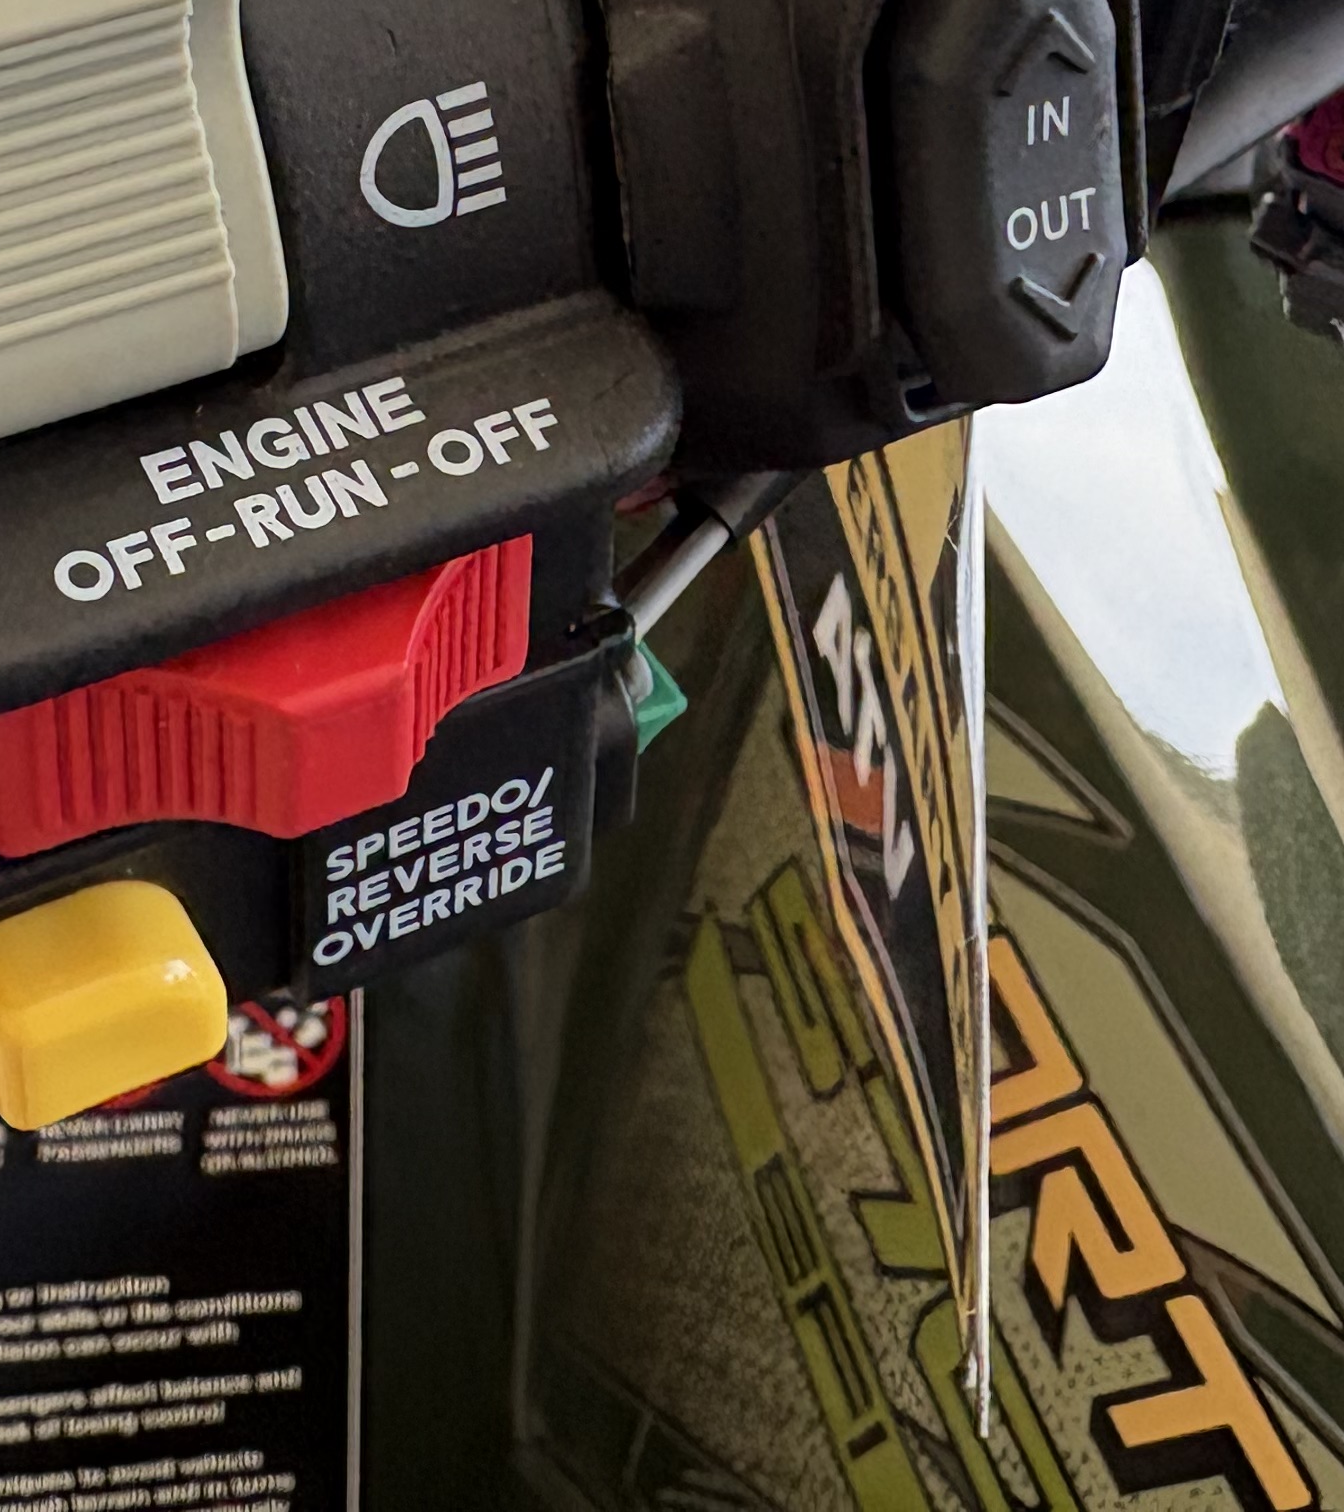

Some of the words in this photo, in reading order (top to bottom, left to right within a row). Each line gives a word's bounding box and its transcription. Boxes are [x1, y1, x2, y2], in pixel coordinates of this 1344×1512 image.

[1027, 95, 1070, 145] IN
[1006, 187, 1097, 251] OUT
[139, 376, 426, 505] ENGINE
[326, 767, 554, 882] SPEEDO/
[327, 806, 554, 926] REVERSE
[312, 841, 566, 966] OVERRIDE
